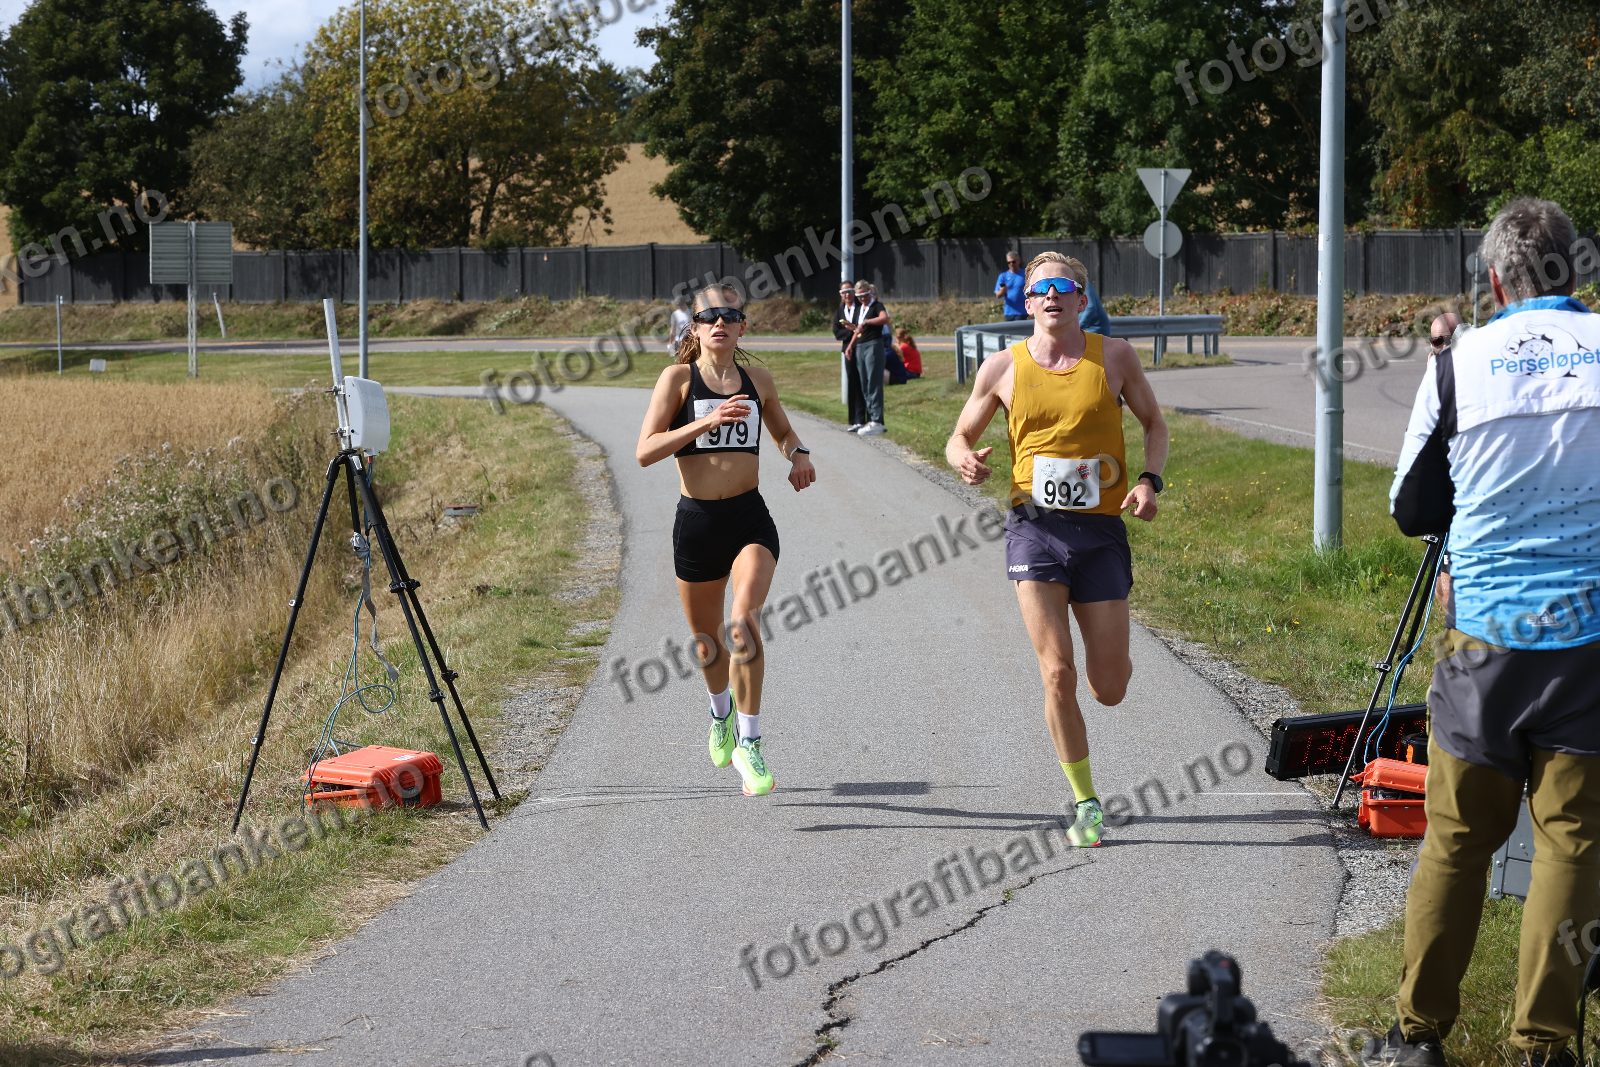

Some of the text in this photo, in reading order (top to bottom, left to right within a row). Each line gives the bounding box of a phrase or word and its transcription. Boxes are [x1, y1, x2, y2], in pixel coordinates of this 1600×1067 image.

[1490, 348, 1600, 376] Perseløpet
[708, 419, 749, 446] 979
[1043, 479, 1087, 507] 992
[1008, 564, 1029, 573] HOKA
